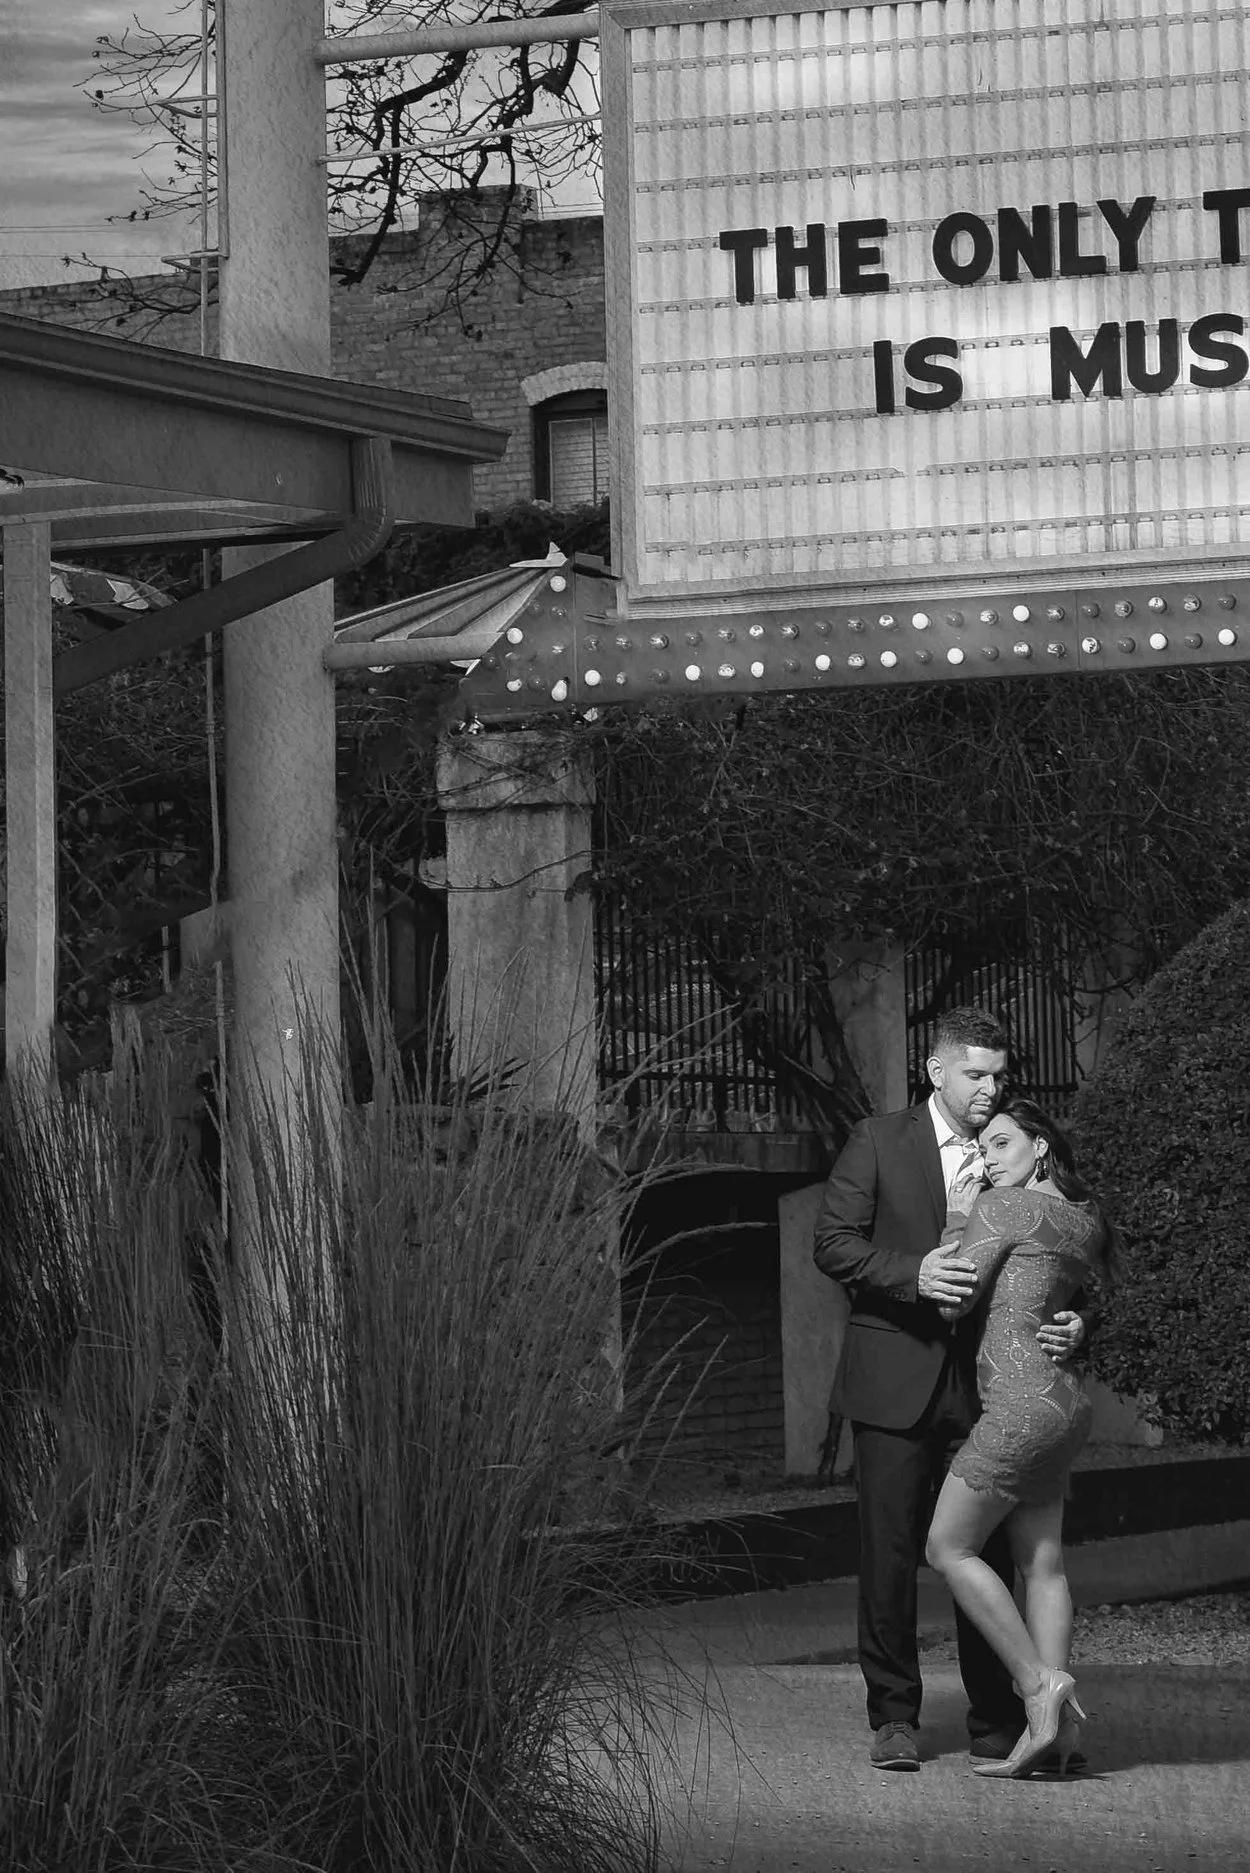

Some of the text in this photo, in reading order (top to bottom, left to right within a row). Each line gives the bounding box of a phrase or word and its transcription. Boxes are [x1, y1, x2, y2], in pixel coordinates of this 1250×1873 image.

[719, 217, 889, 303] THE
[932, 195, 1157, 286] ONLY
[872, 335, 963, 414] IS
